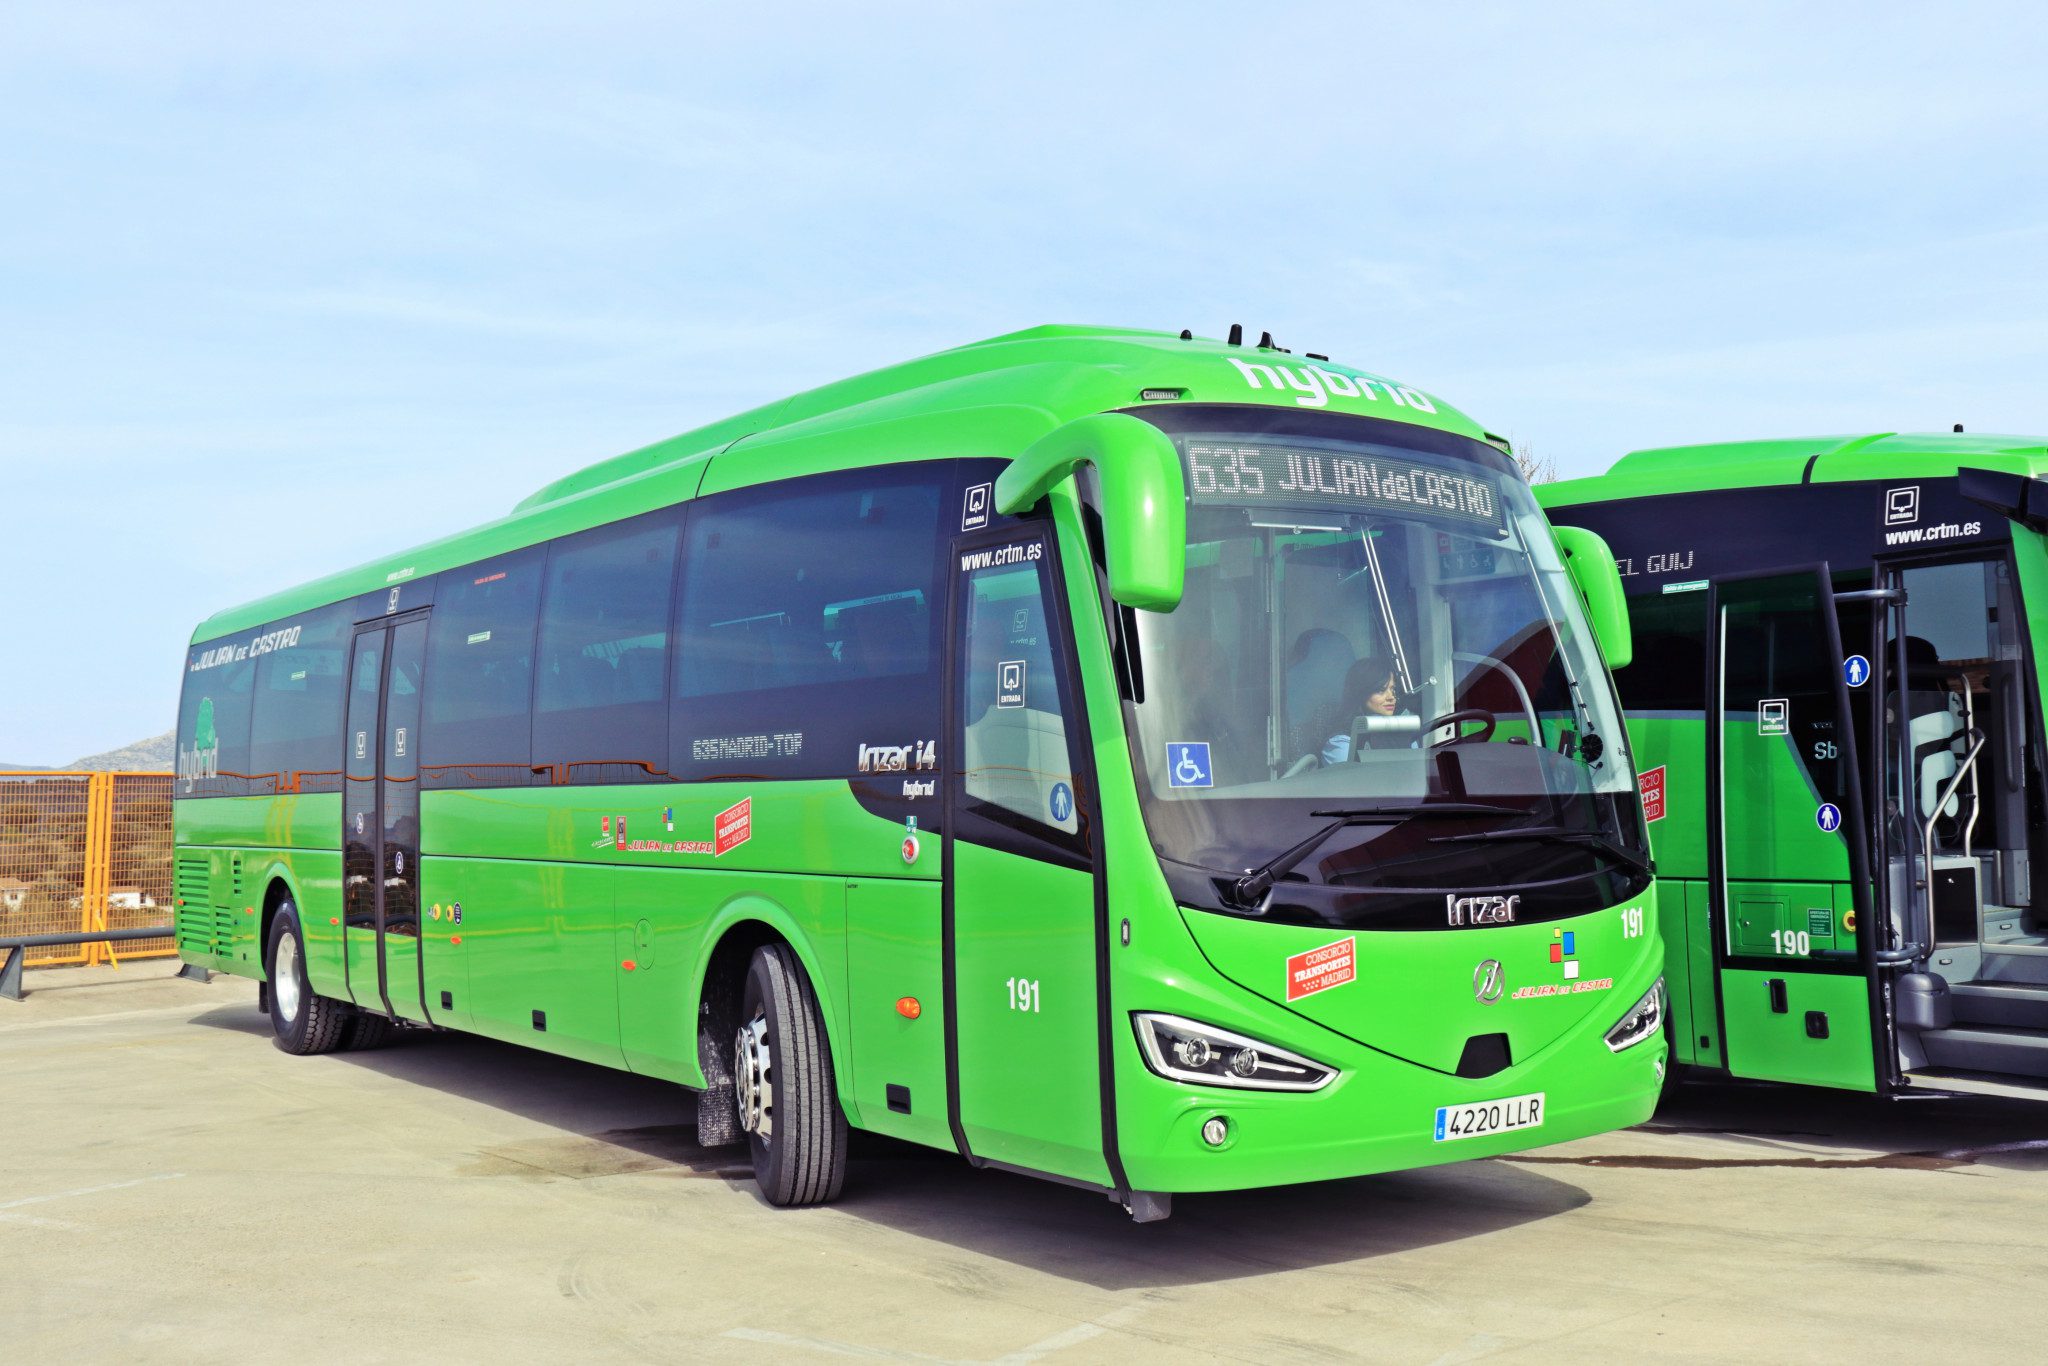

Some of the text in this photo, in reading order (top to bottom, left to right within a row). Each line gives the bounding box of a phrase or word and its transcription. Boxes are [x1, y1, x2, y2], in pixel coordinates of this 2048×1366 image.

[1228, 357, 1437, 414] hybrid
[1189, 447, 1265, 494] 635
[1885, 521, 1981, 545] www.crtm.es
[961, 543, 1042, 571] www.crtm.es
[1647, 550, 1694, 573] GUIJ
[191, 644, 237, 672] JULIAN
[249, 625, 302, 658] CASTRO
[1001, 695, 1021, 703] ENTRADA
[859, 739, 936, 772] Irizar i4
[902, 780, 935, 801] hybrid
[628, 840, 662, 852] JULIAN
[674, 841, 714, 855] CASTRO
[1446, 893, 1521, 926] Irizar
[1620, 906, 1643, 939] 191
[1305, 942, 1351, 966] CONSORCIO
[1770, 929, 1810, 956] 190
[1294, 955, 1351, 983] TRANSPORTES
[1321, 967, 1351, 987] MADRID
[1006, 976, 1040, 1013] 191
[1511, 983, 1559, 999] JULIAN
[1572, 977, 1613, 993] CASTRO
[1449, 1098, 1540, 1136] 4220 LLR
[1437, 1127, 1443, 1136] E
